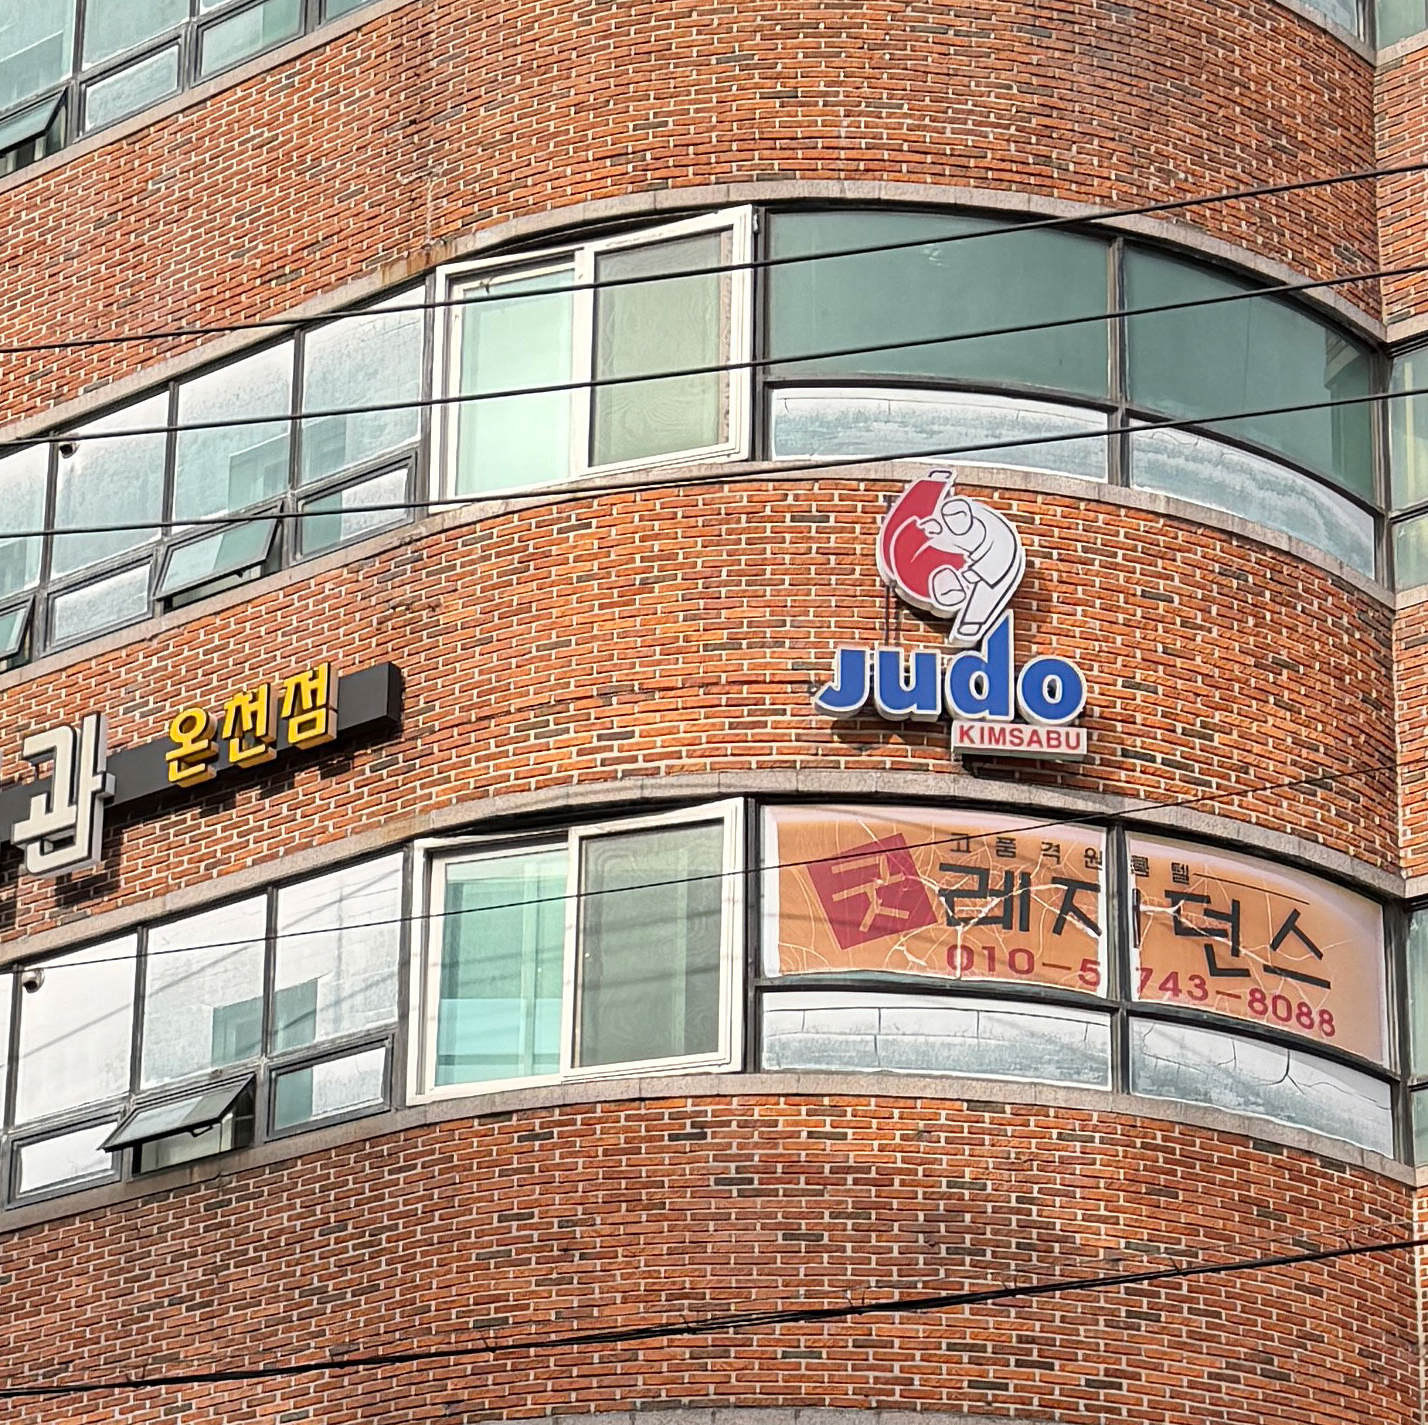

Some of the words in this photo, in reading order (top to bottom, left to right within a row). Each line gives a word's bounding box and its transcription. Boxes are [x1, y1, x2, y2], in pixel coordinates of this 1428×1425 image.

[163, 662, 337, 786] 온천점
[958, 727, 1082, 752] KIMSABU
[831, 858, 909, 934] 굿
[939, 862, 1331, 990] 레지던스
[946, 943, 1337, 1038] 010-5743-8088
